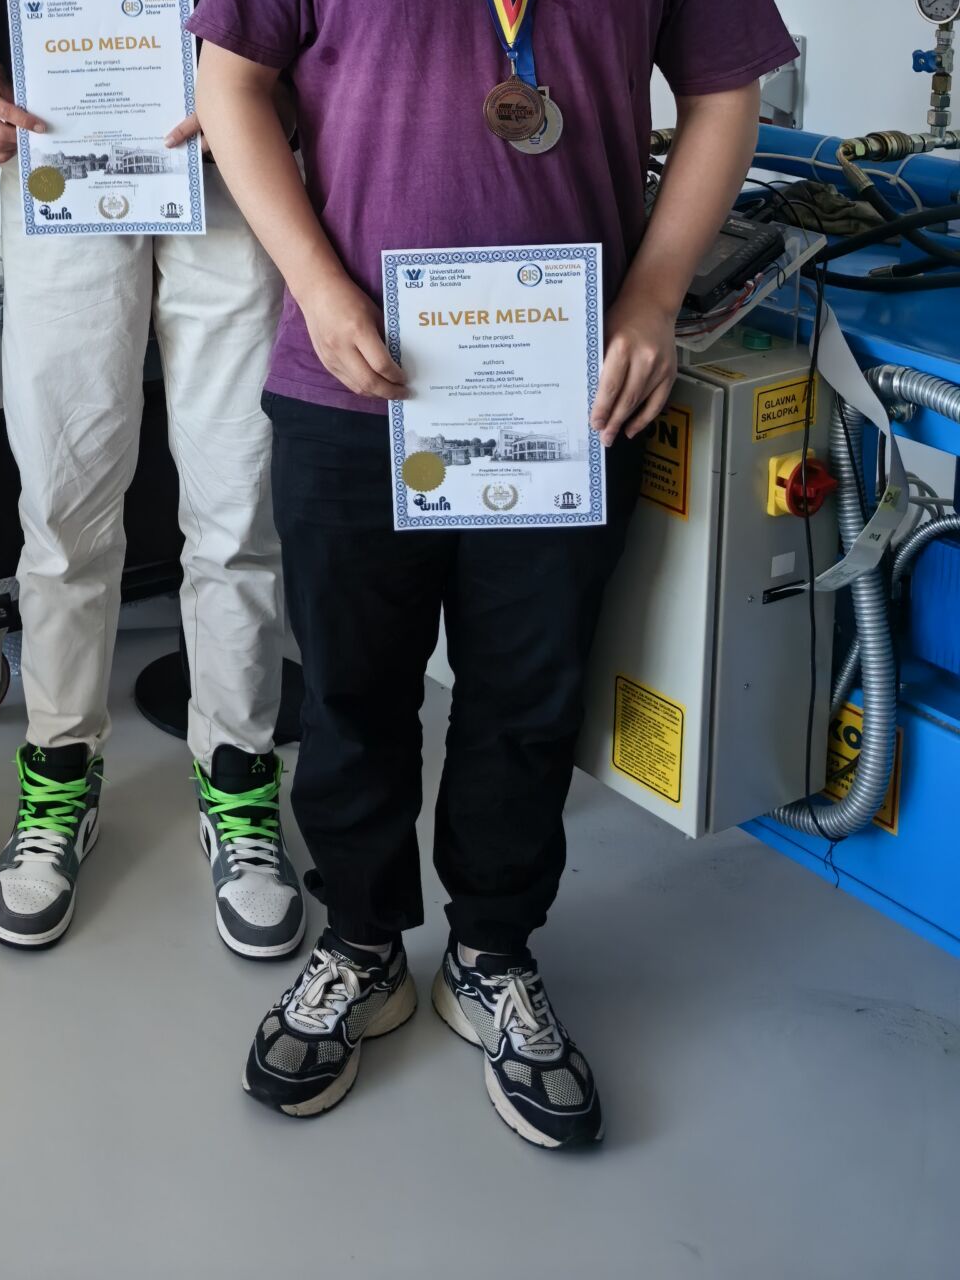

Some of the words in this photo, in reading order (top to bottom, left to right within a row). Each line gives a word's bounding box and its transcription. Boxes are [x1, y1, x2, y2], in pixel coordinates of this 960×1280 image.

[125, 1, 140, 12] BIS
[45, 38, 93, 53] GOLD
[98, 35, 161, 51] MEDAL
[521, 269, 539, 282] BIS
[418, 310, 490, 326] SILVER
[496, 307, 569, 324] MEDAL
[764, 394, 797, 409] GLAVNA
[761, 405, 799, 422] SKLOPKA
